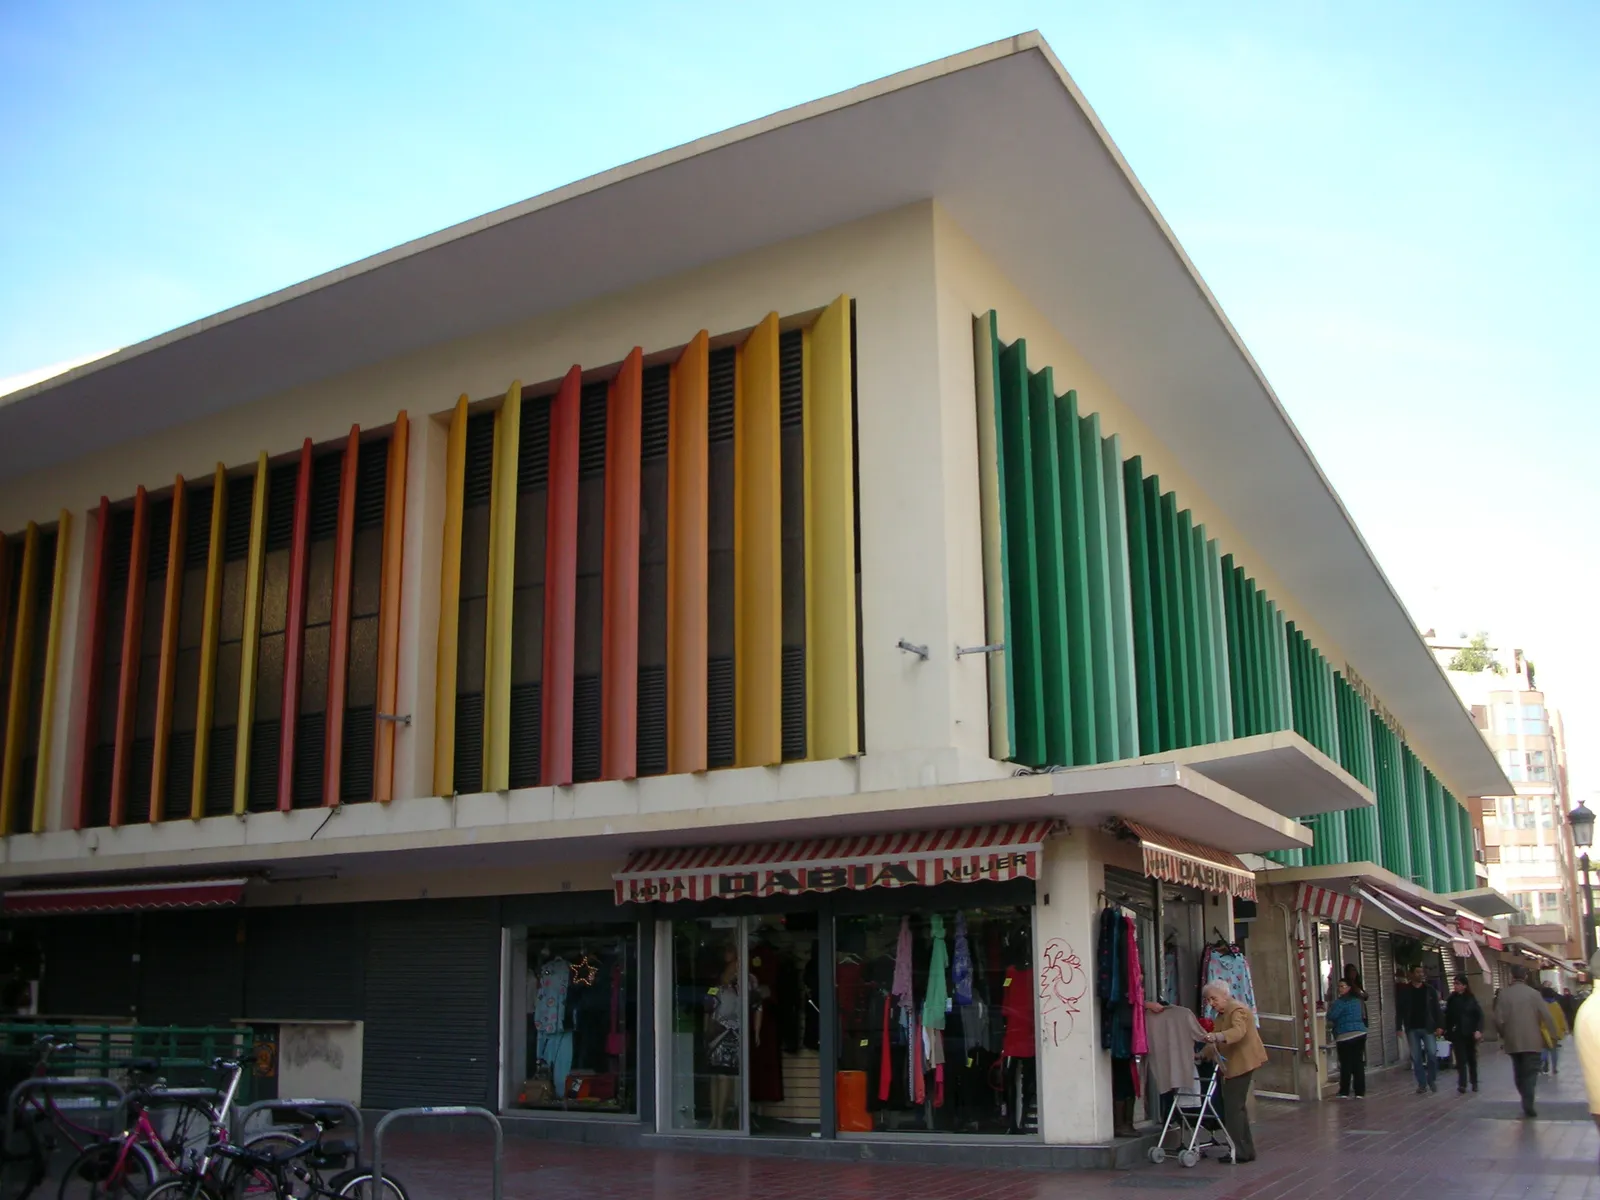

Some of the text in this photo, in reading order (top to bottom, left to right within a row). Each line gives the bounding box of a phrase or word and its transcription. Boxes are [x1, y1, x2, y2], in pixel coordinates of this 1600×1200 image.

[630, 854, 1027, 899] MODA DABIA MUJER
